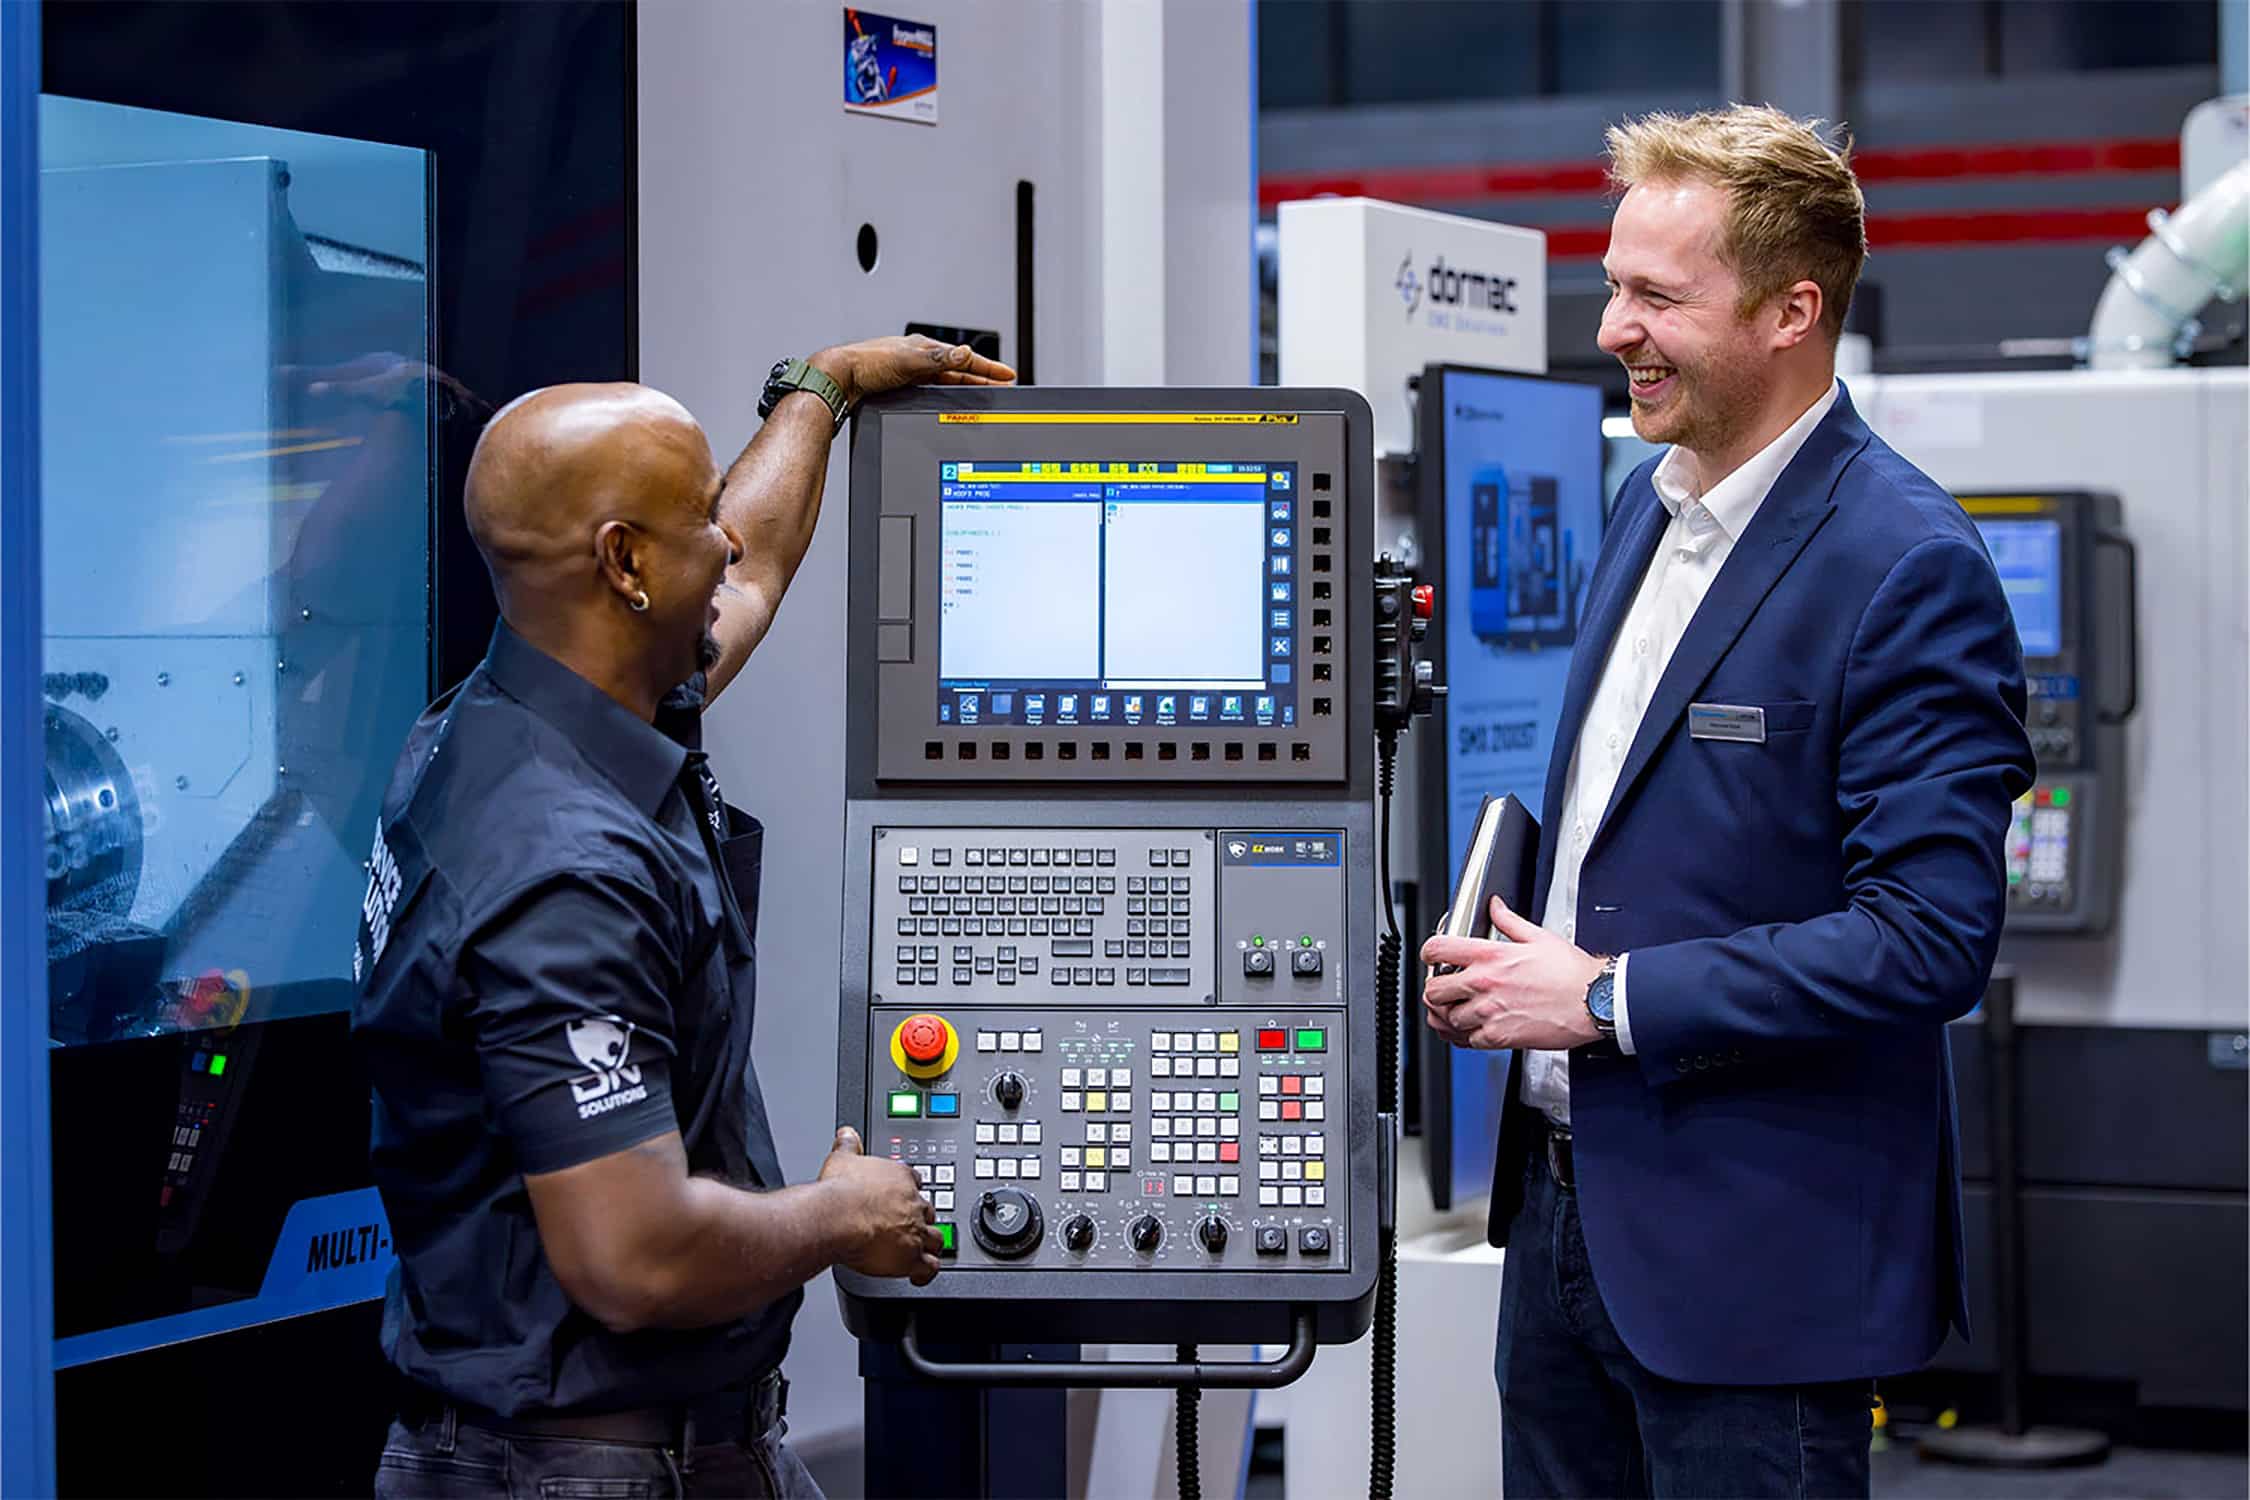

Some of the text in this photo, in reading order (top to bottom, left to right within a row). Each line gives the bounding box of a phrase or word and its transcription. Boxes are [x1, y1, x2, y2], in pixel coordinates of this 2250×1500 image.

[1430, 255, 1517, 314] dormac
[577, 1084, 648, 1119] SOLUTIONS
[306, 1223, 396, 1273] MULTI-
